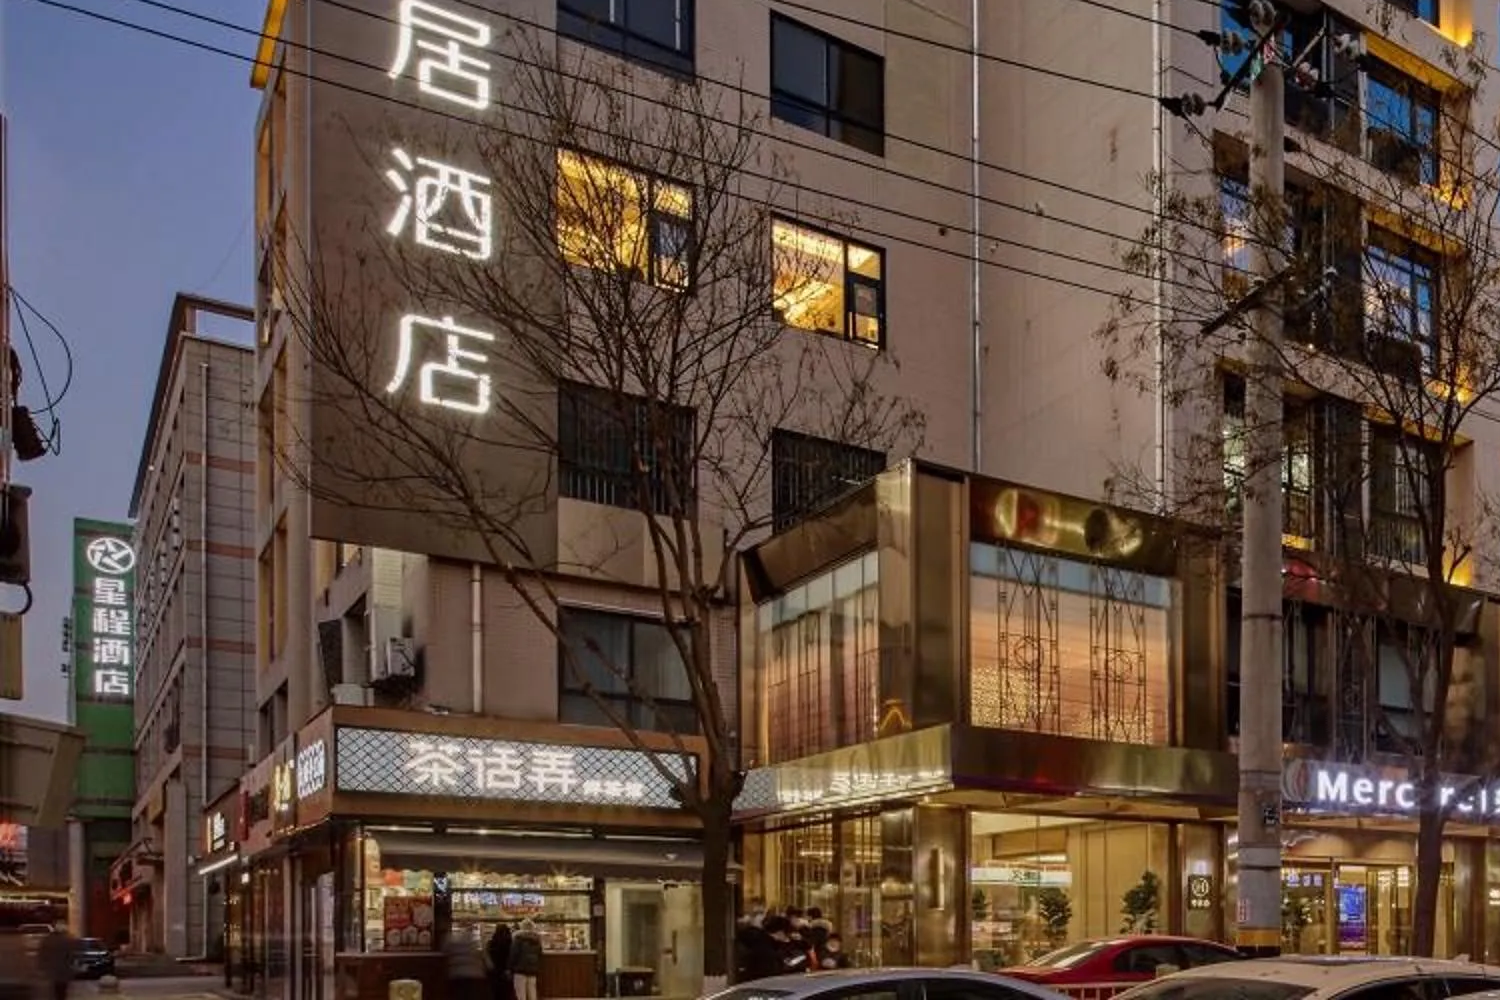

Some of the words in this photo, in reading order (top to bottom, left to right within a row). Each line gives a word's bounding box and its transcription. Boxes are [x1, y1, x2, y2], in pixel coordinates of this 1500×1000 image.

[93, 577, 132, 695] 星程酒店
[403, 741, 578, 794] 茶话弄
[1316, 769, 1474, 812] Mercr
